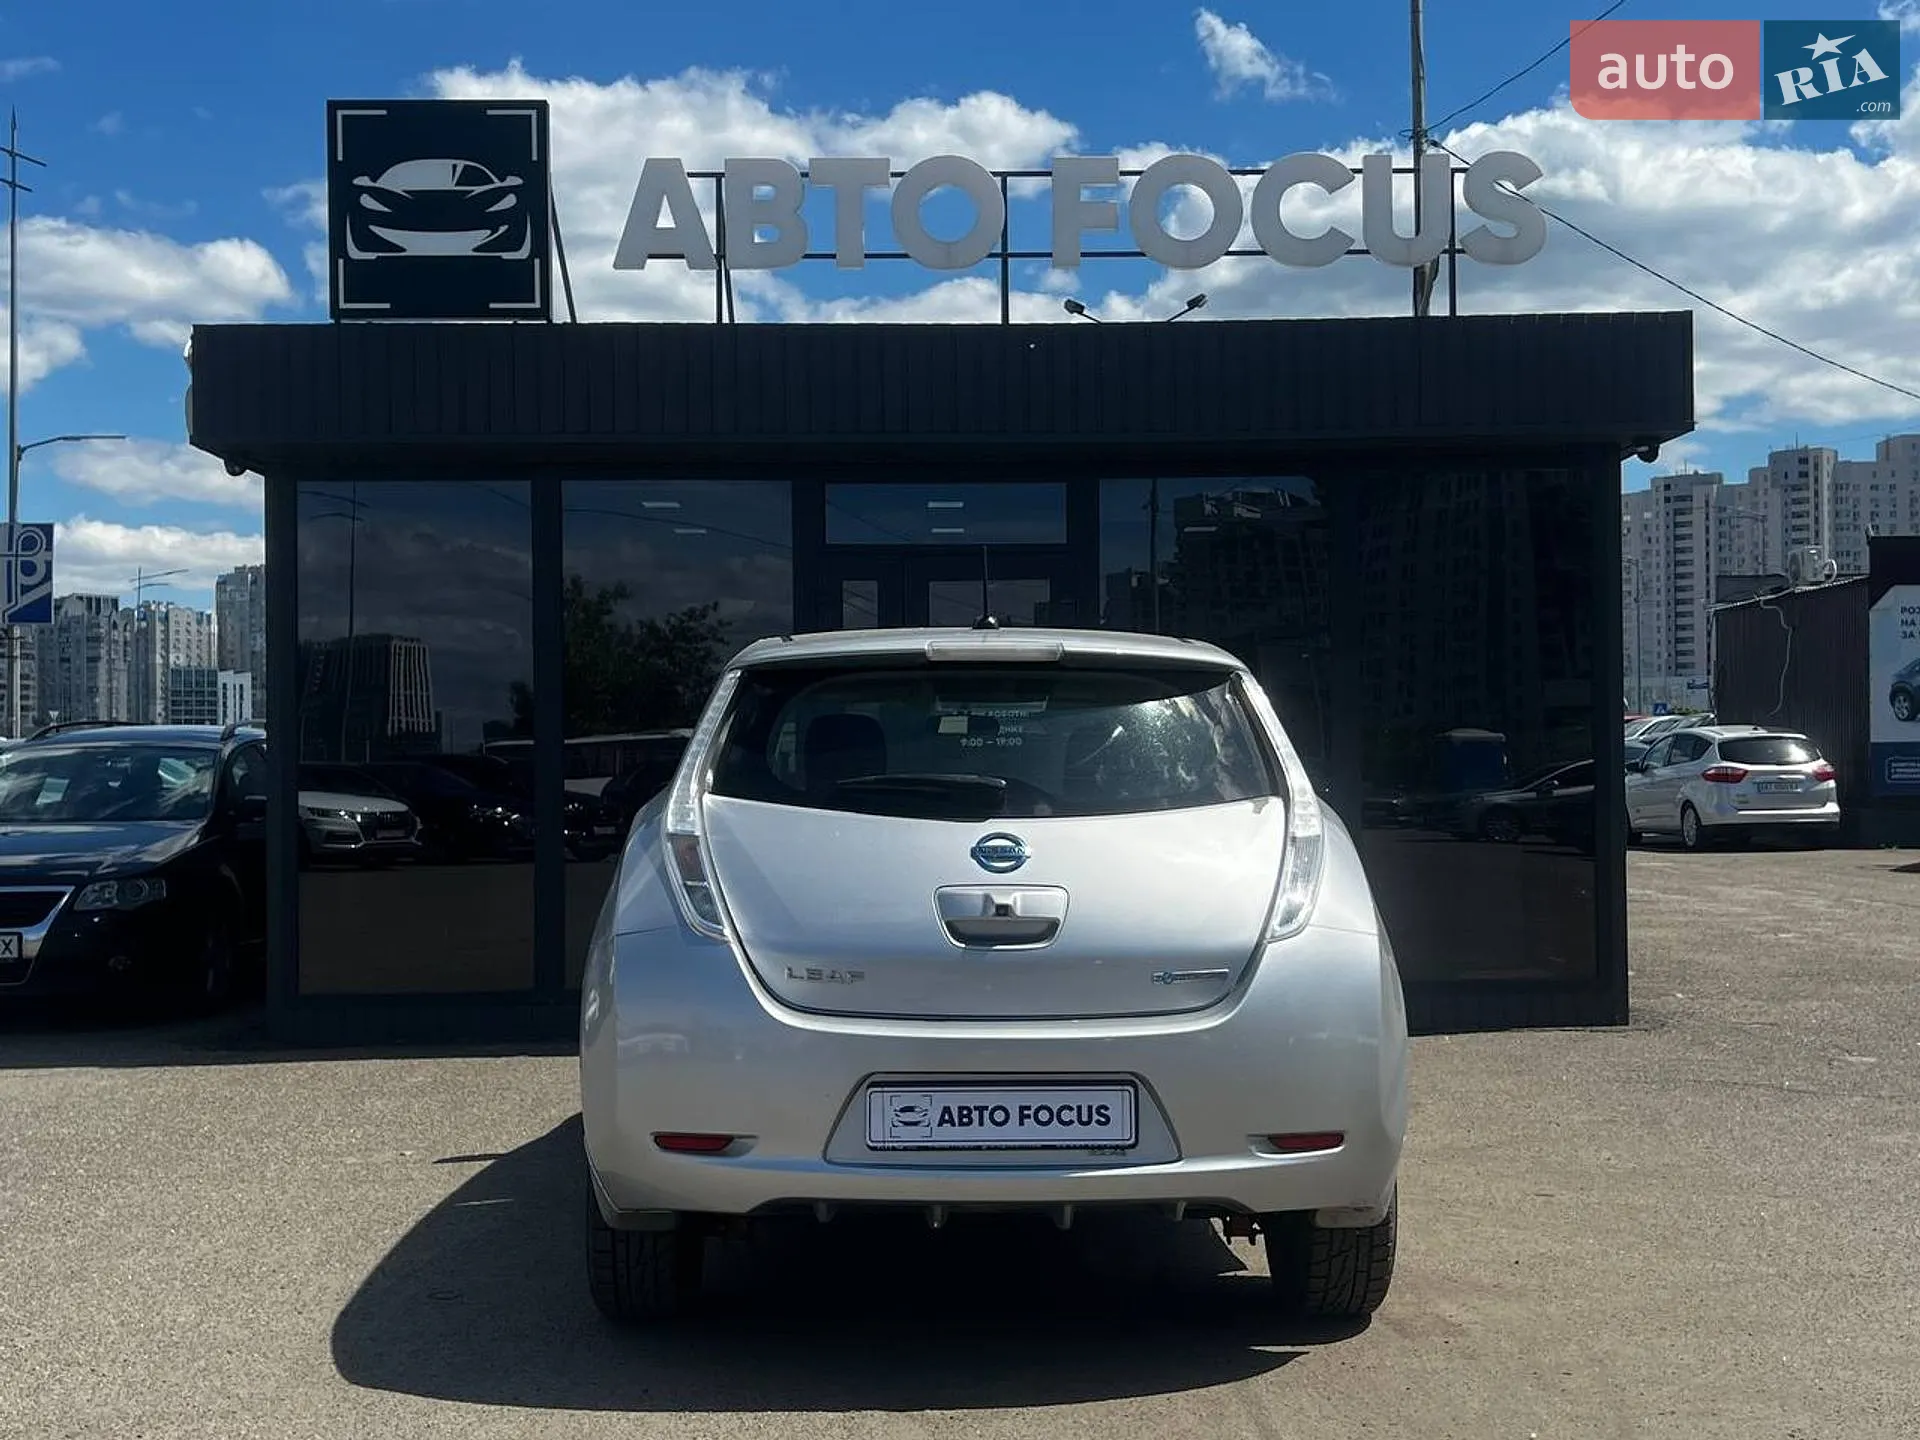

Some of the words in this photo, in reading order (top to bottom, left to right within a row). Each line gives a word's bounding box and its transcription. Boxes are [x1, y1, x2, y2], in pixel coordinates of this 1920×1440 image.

[612, 154, 1006, 271] АВТО
[1051, 151, 1548, 270] FOCUS
[785, 967, 865, 984] LEAF
[937, 1104, 1011, 1128] АВТО
[1018, 1103, 1112, 1127] FOCUS
